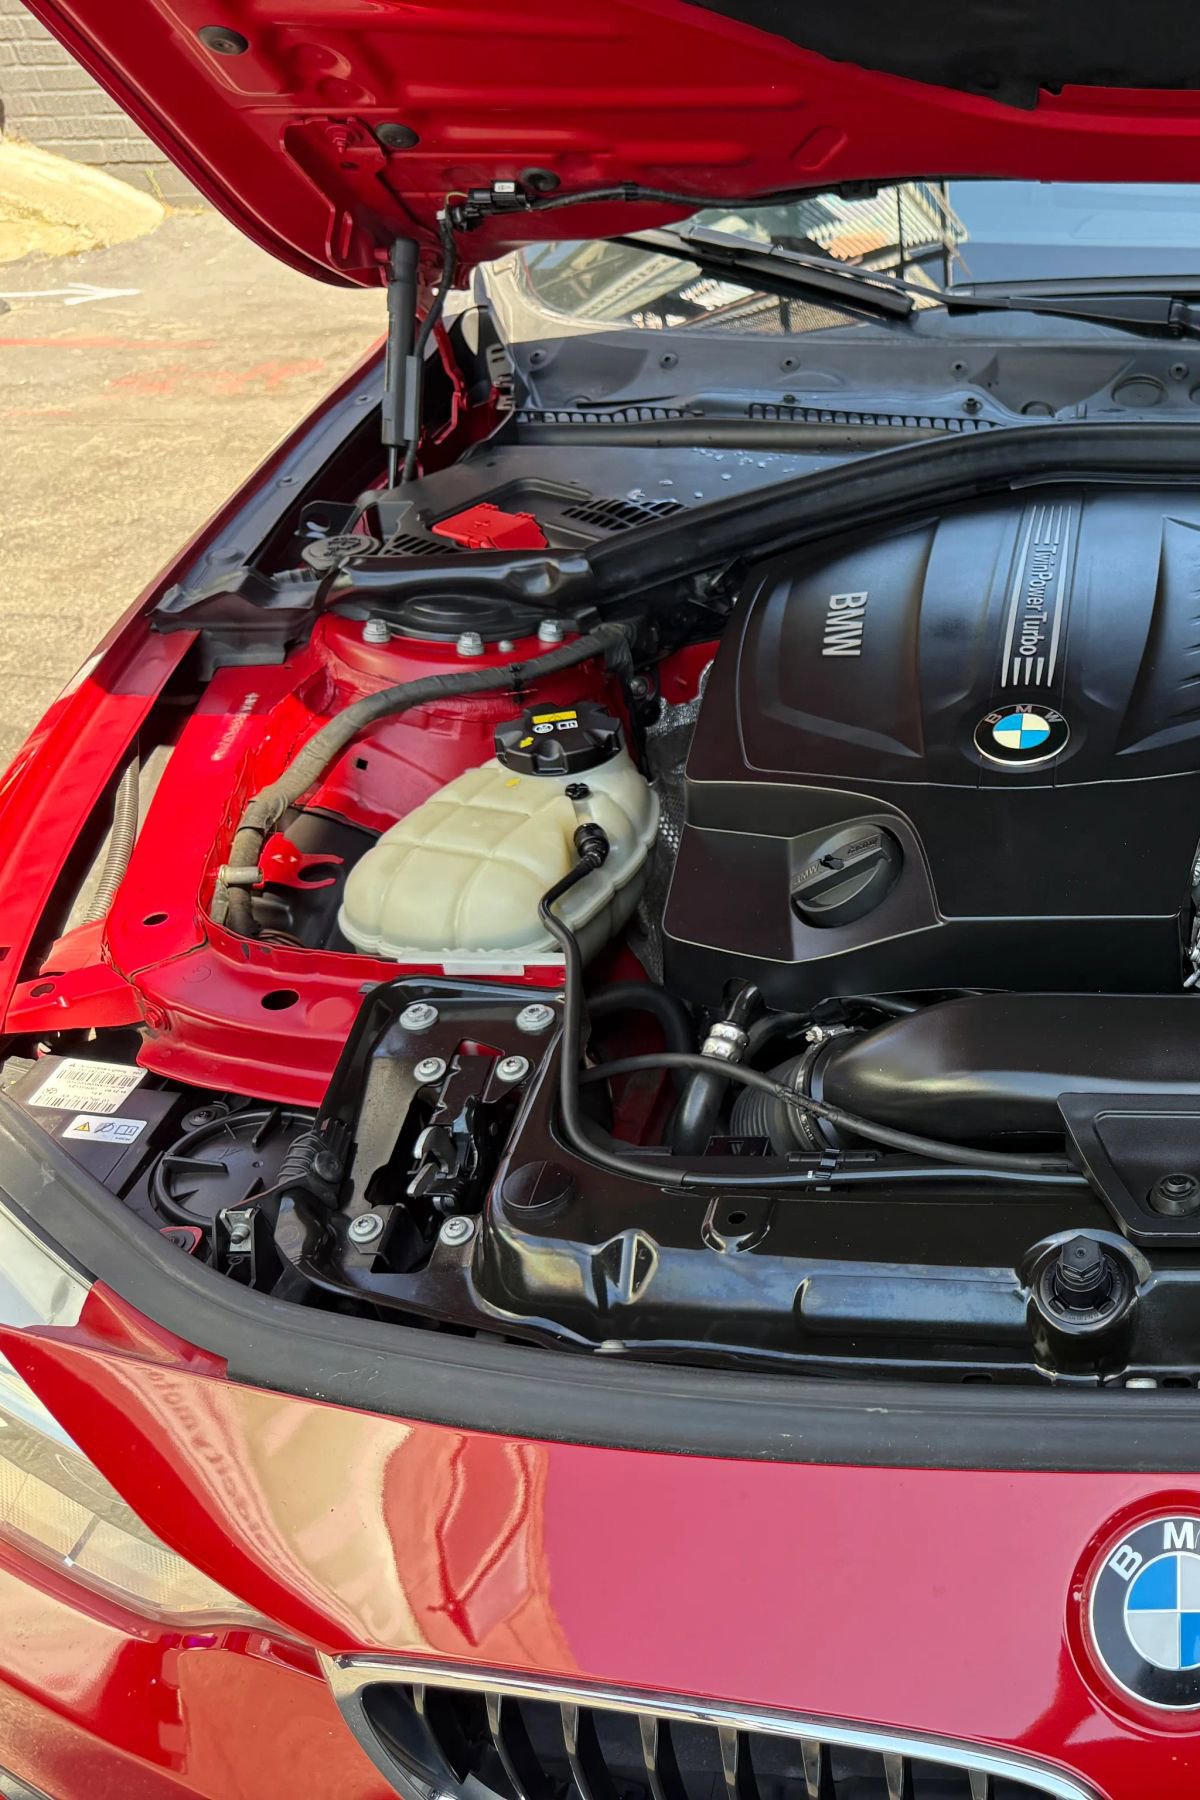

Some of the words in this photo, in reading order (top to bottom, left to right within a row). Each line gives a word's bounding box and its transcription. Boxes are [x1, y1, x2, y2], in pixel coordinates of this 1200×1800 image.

[1026, 546, 1057, 613] TwinPower
[822, 592, 869, 656] BMW
[1019, 611, 1048, 656] Turbo
[984, 705, 1063, 724] BMW
